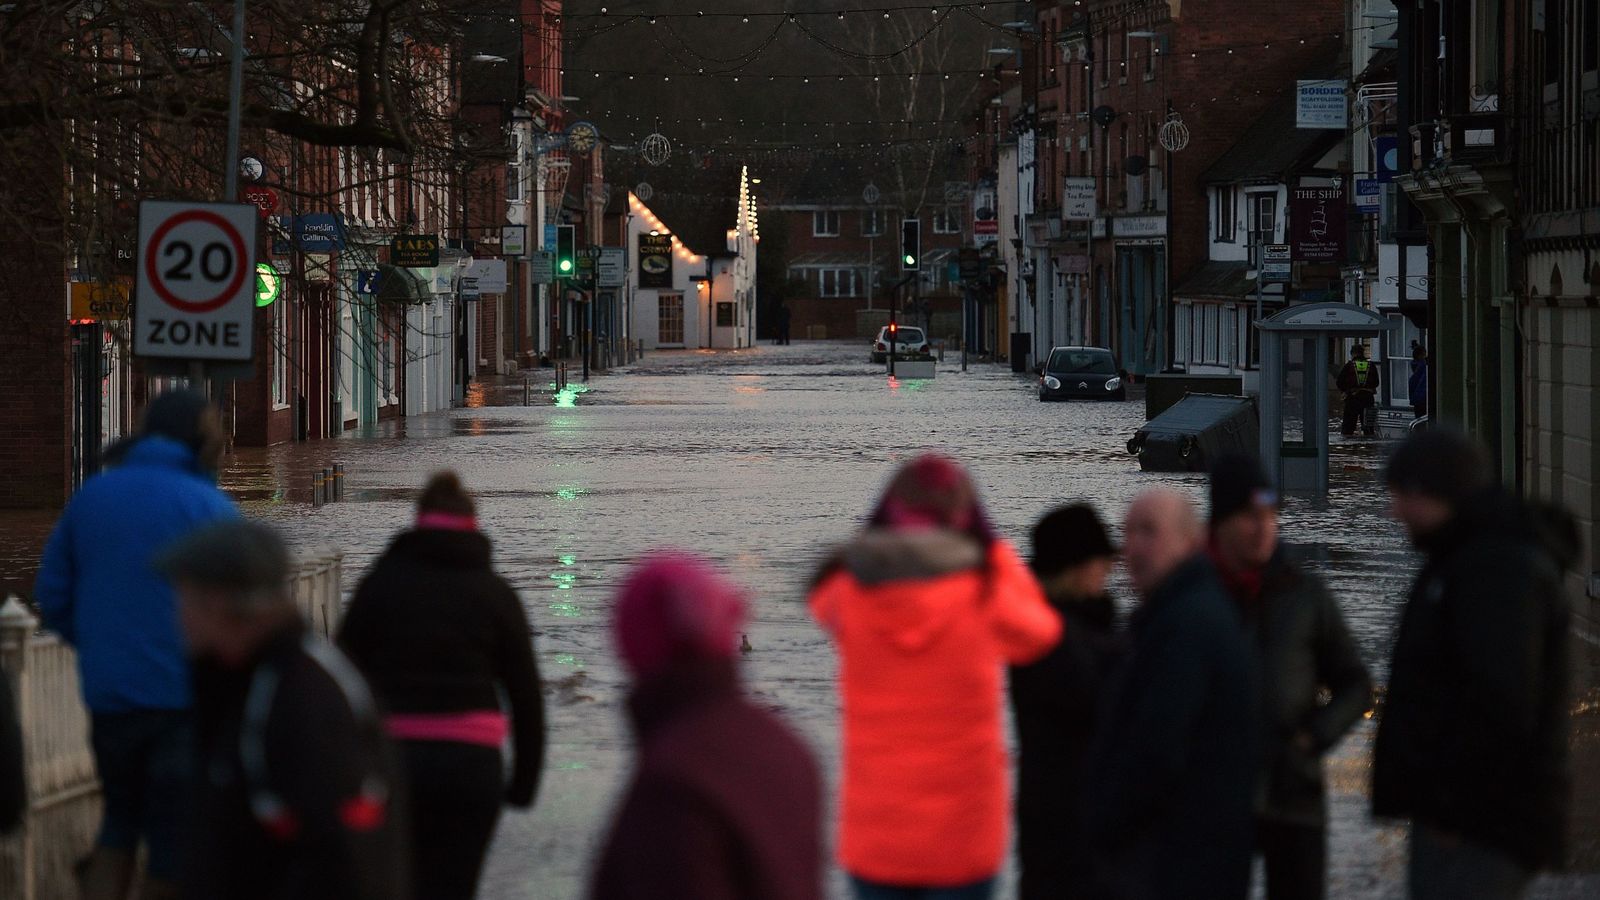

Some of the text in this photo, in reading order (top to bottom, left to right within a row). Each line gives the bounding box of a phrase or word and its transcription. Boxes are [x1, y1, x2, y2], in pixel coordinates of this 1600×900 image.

[1295, 190, 1342, 199] THE SHIP
[305, 224, 335, 232] Franklin
[163, 241, 232, 281] 20
[147, 319, 238, 347] ZONE
